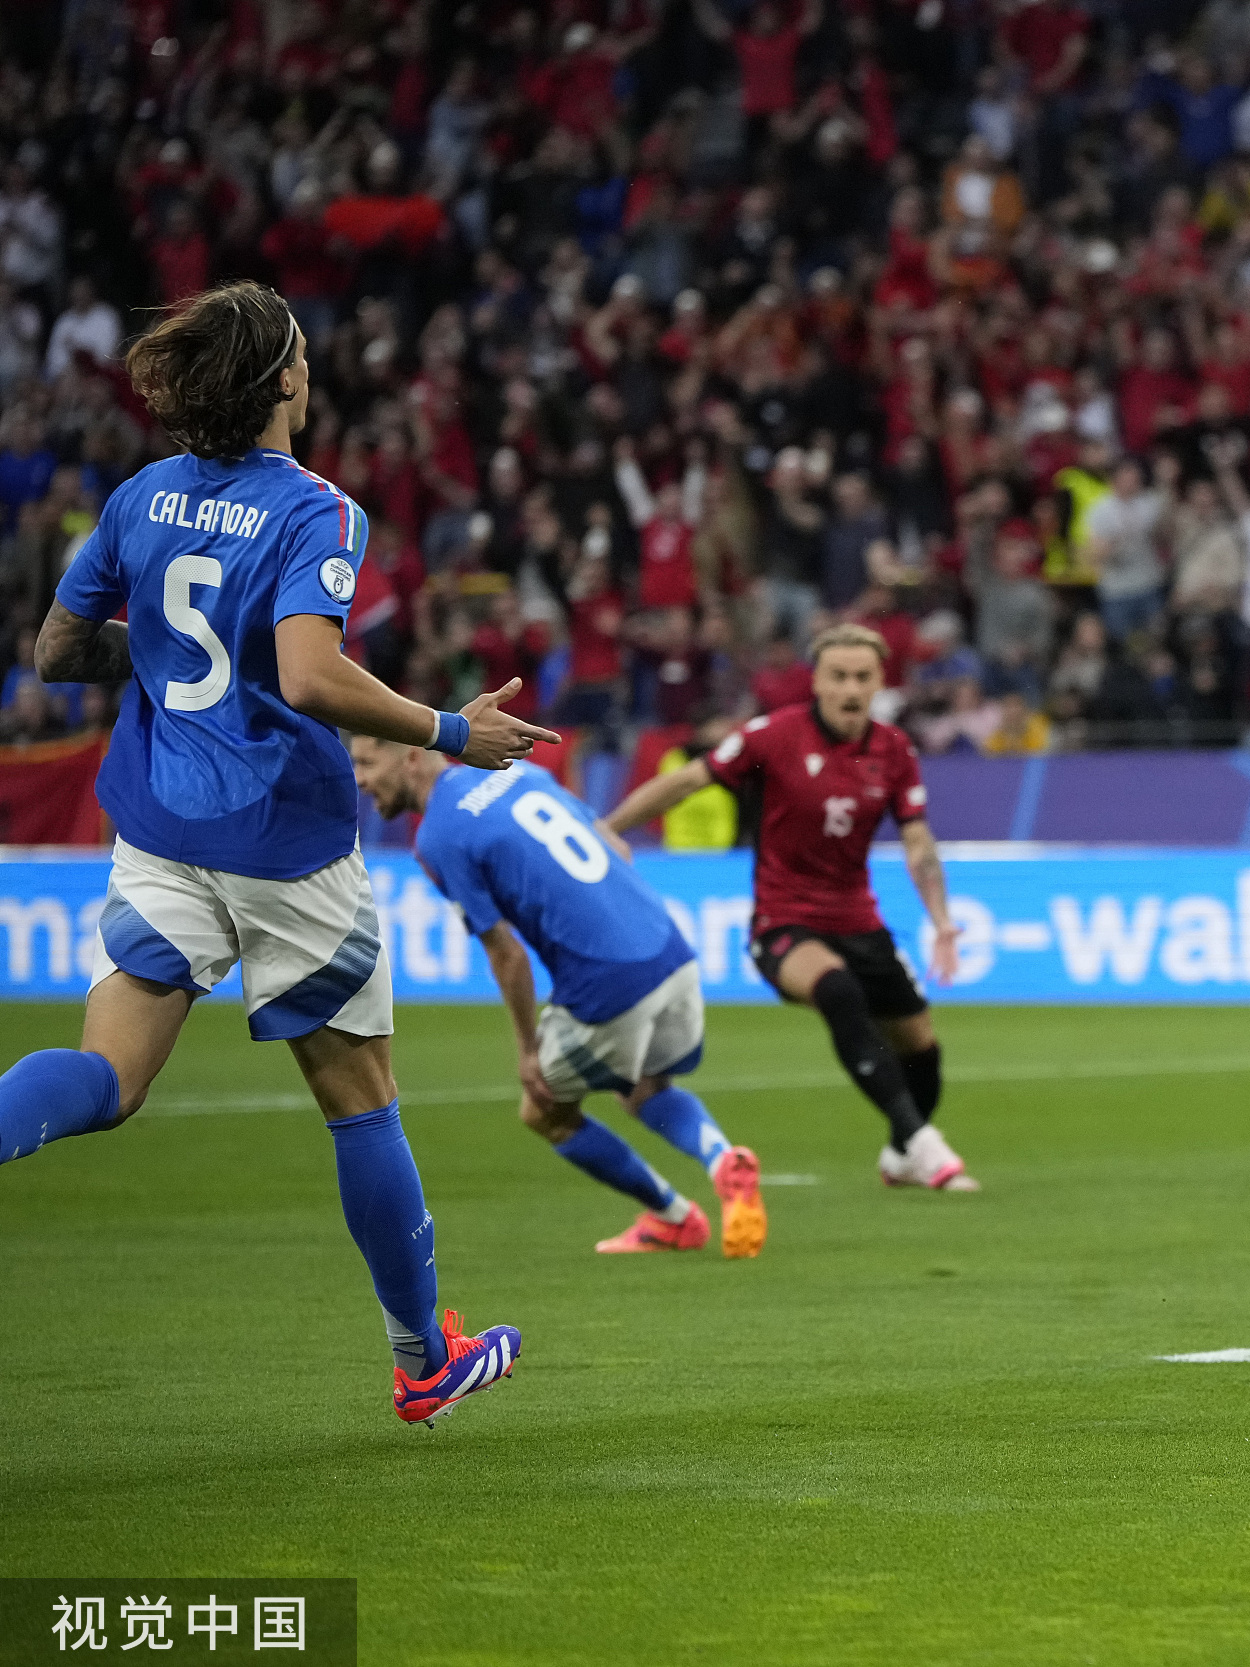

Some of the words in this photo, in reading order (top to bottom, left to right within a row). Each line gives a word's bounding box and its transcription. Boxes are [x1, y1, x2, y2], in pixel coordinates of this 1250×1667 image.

[149, 490, 268, 540] CALAFIORI
[163, 555, 231, 712] 5
[511, 790, 609, 884] 8
[822, 796, 858, 838] 15
